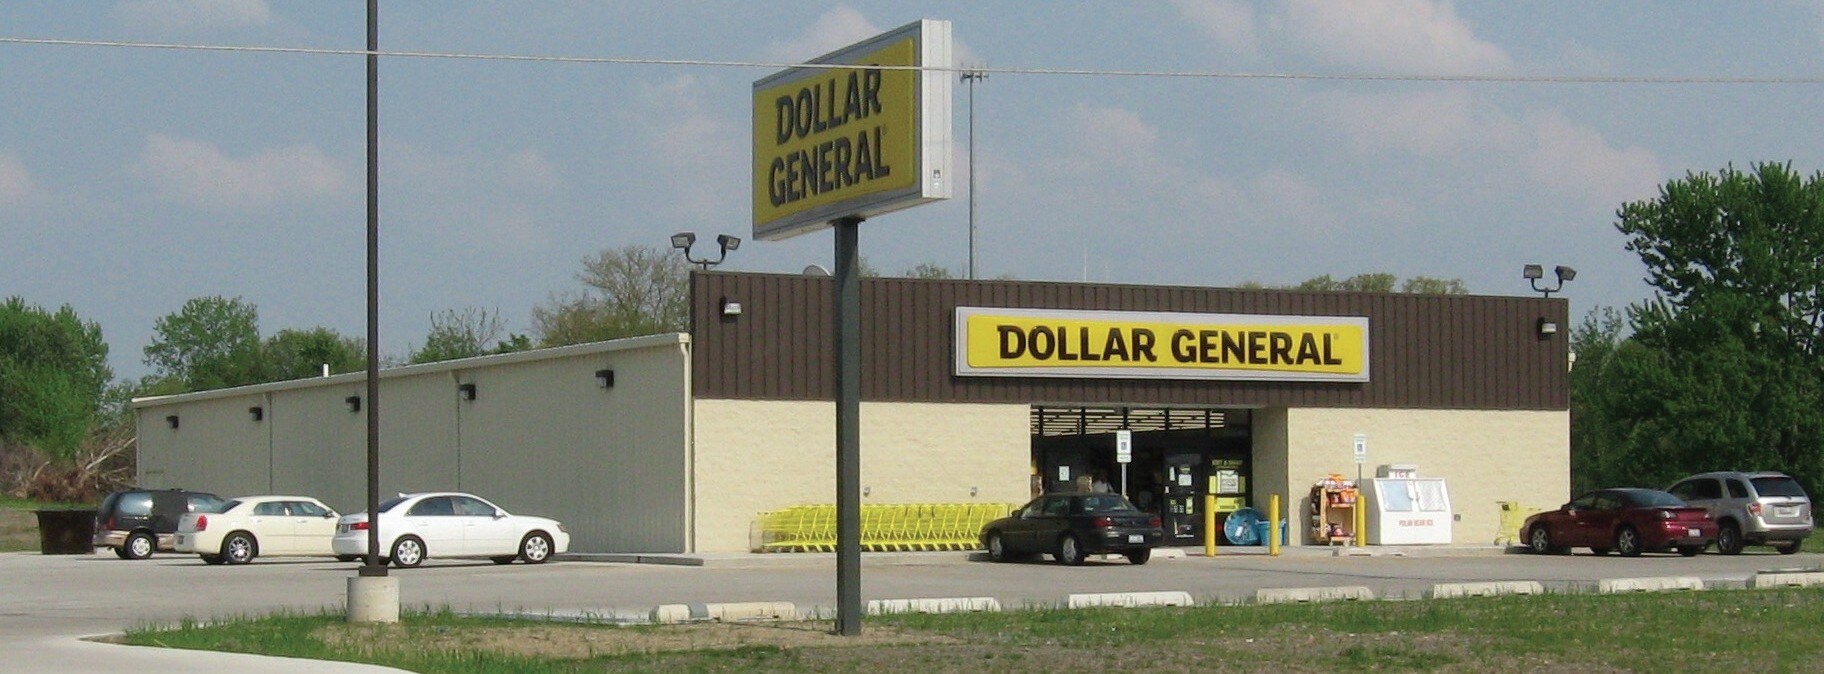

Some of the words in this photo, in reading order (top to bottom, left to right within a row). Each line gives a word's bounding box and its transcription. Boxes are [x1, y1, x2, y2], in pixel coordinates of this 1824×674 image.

[776, 64, 882, 146] DOLLAR
[768, 126, 890, 207] GENERAL
[997, 324, 1157, 362] DOLLAR
[1170, 328, 1342, 366] GENERAL
